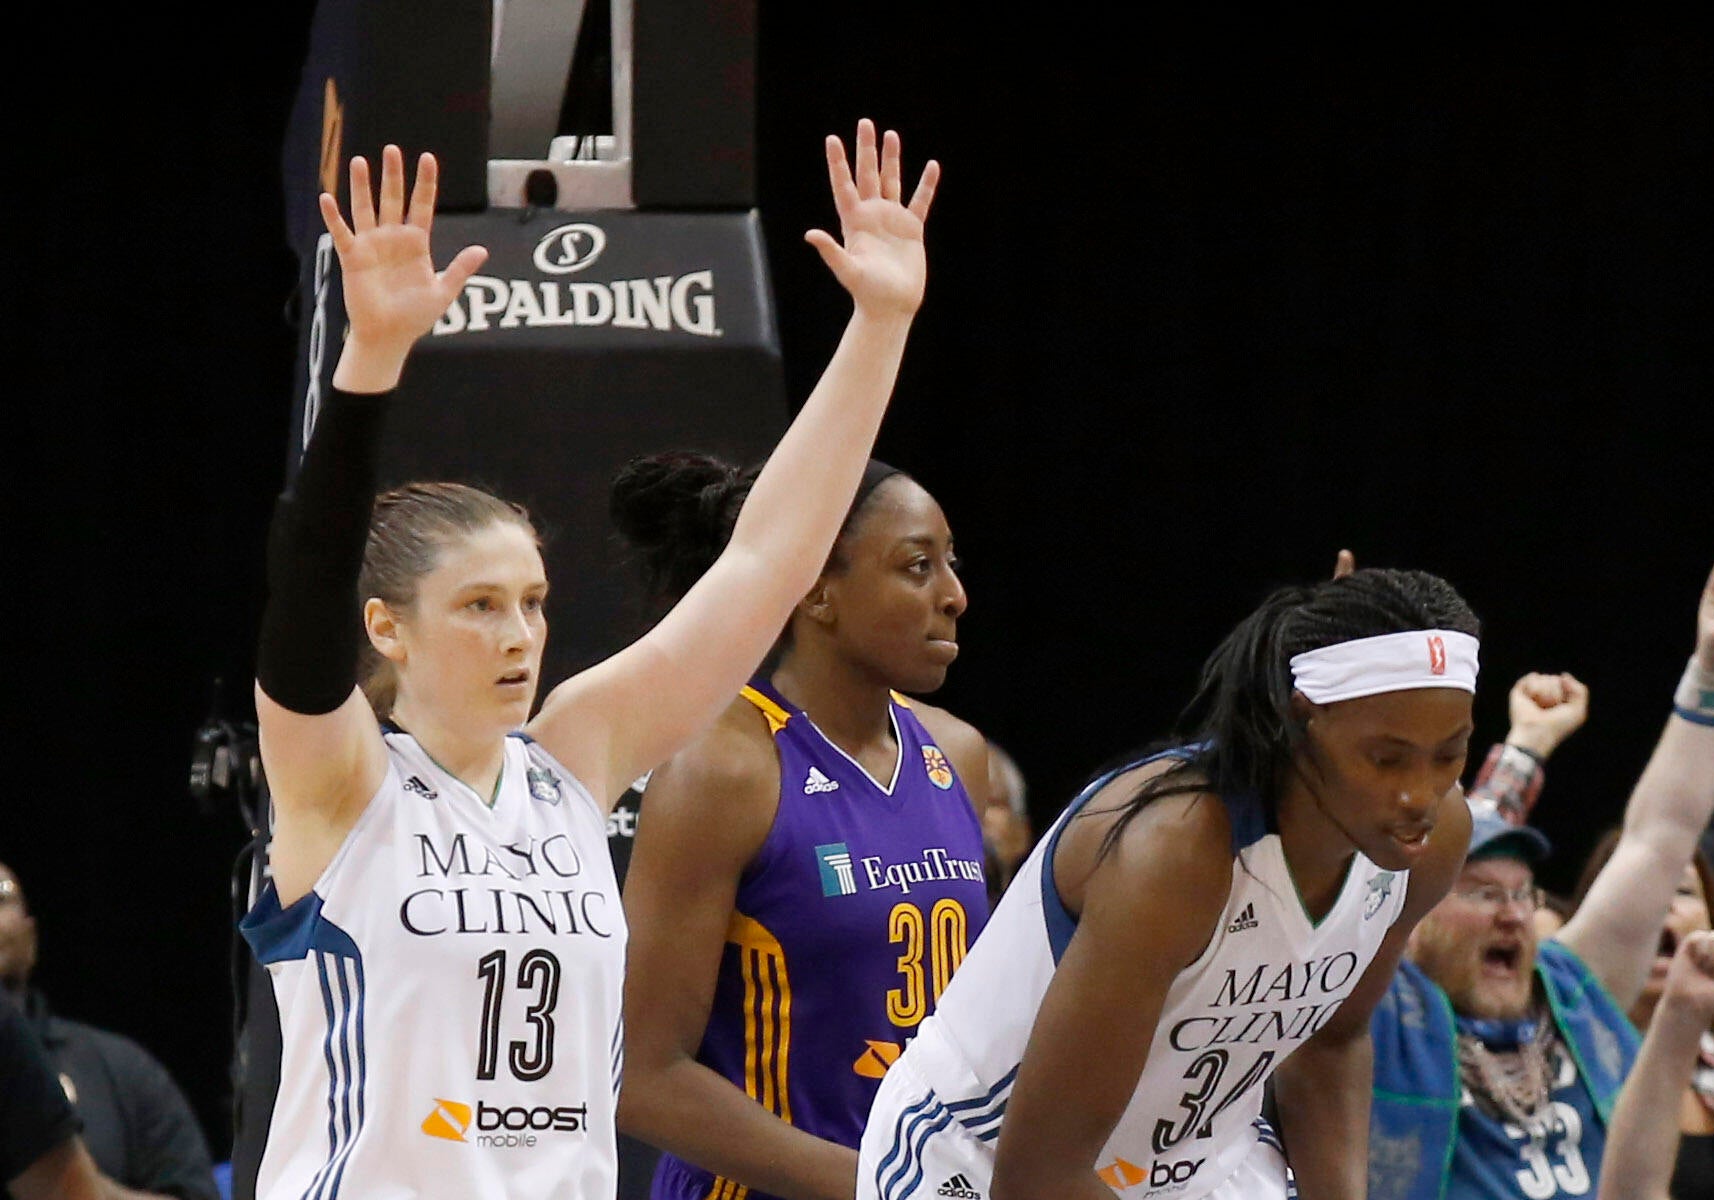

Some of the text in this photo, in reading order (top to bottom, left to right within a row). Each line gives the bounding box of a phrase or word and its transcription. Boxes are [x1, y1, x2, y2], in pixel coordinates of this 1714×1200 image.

[413, 832, 581, 881] MAYO
[860, 848, 985, 894] EquiTrust
[399, 888, 613, 938] CLINIC
[886, 898, 968, 1027] 30
[1207, 950, 1358, 1008] MAYO
[475, 948, 561, 1082] 13
[1168, 997, 1349, 1052] CLINIC
[476, 1100, 588, 1132] boost
[477, 1133, 537, 1148] mobile
[937, 1187, 981, 1200] adidas
